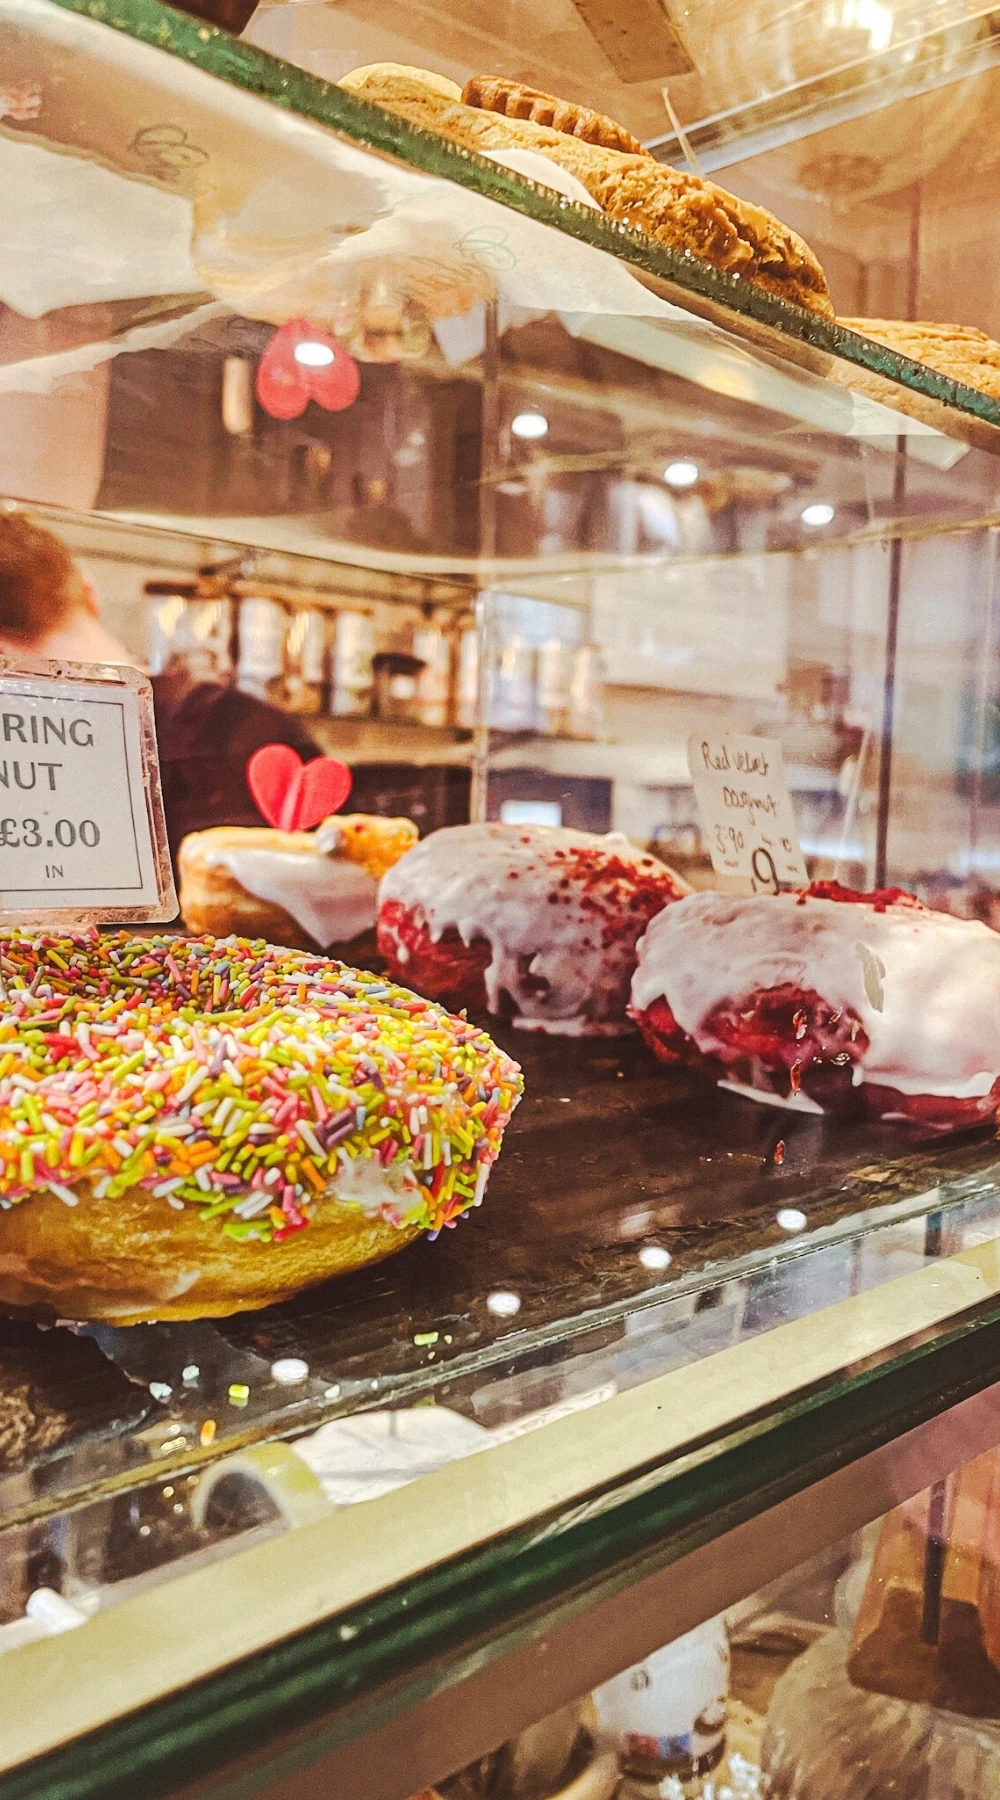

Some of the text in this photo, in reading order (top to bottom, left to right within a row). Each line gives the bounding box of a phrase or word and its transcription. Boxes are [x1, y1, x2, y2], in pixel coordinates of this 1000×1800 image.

[2, 713, 93, 747] RING
[702, 741, 730, 771] Red
[0, 818, 100, 848] £3.00
[45, 864, 64, 879] IN
